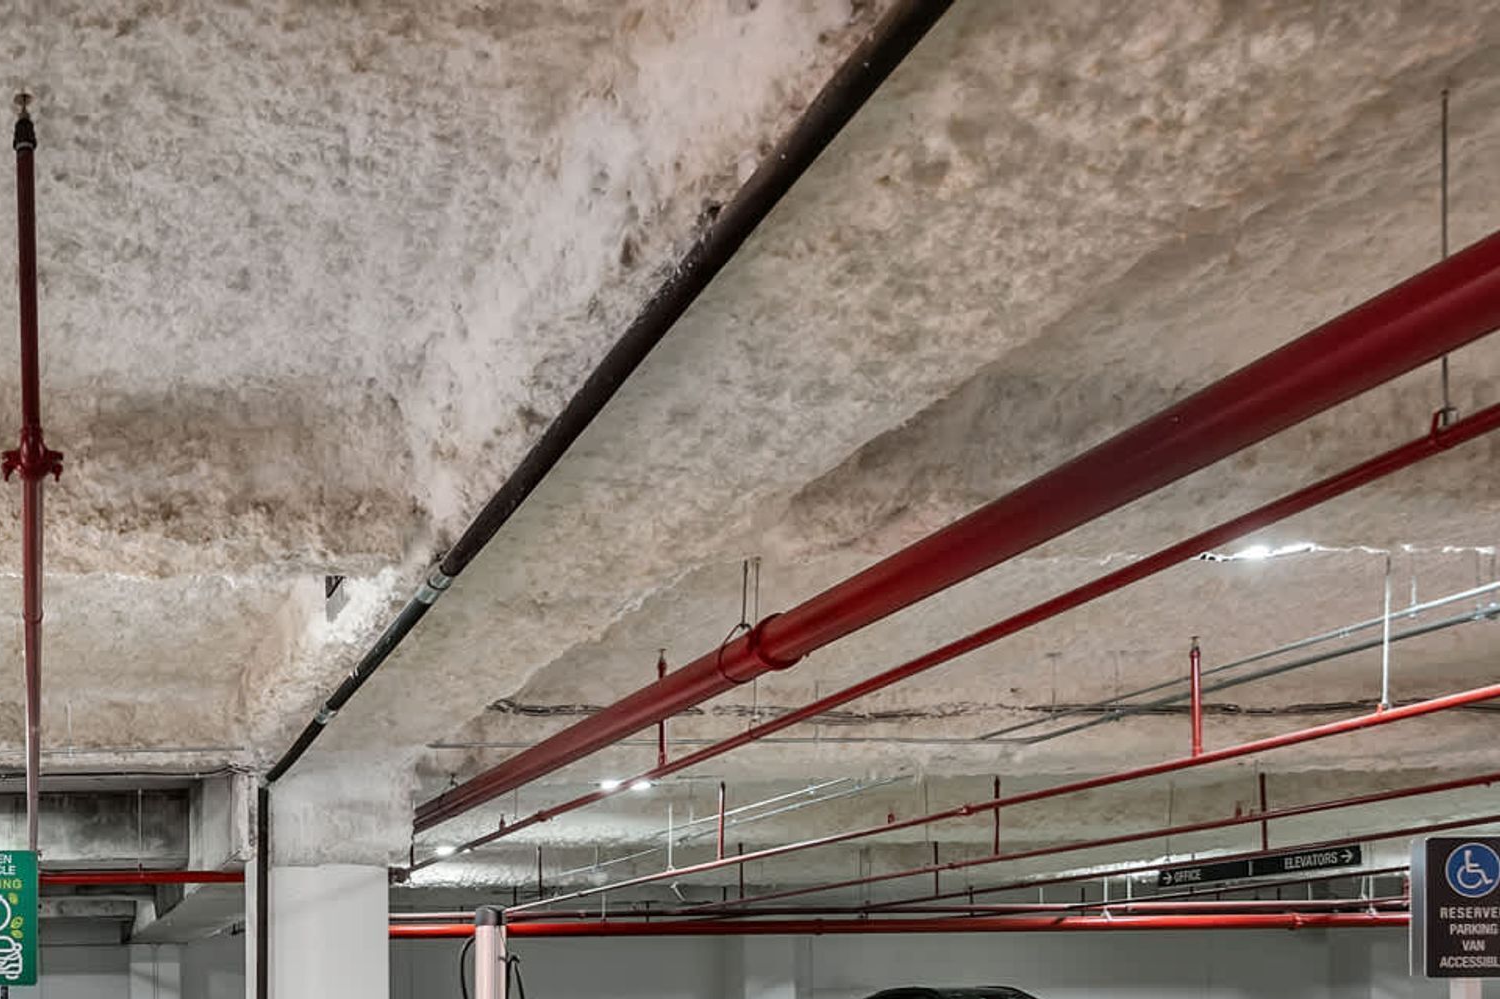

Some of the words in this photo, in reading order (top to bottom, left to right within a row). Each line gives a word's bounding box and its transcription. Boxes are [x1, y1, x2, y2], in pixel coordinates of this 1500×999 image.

[1284, 851, 1339, 870] ELEVATORS
[1440, 906, 1500, 919] RESERVE
[1449, 923, 1499, 935] PARKING
[1462, 940, 1486, 952] VAN
[1440, 956, 1500, 968] ACCESSIBL
